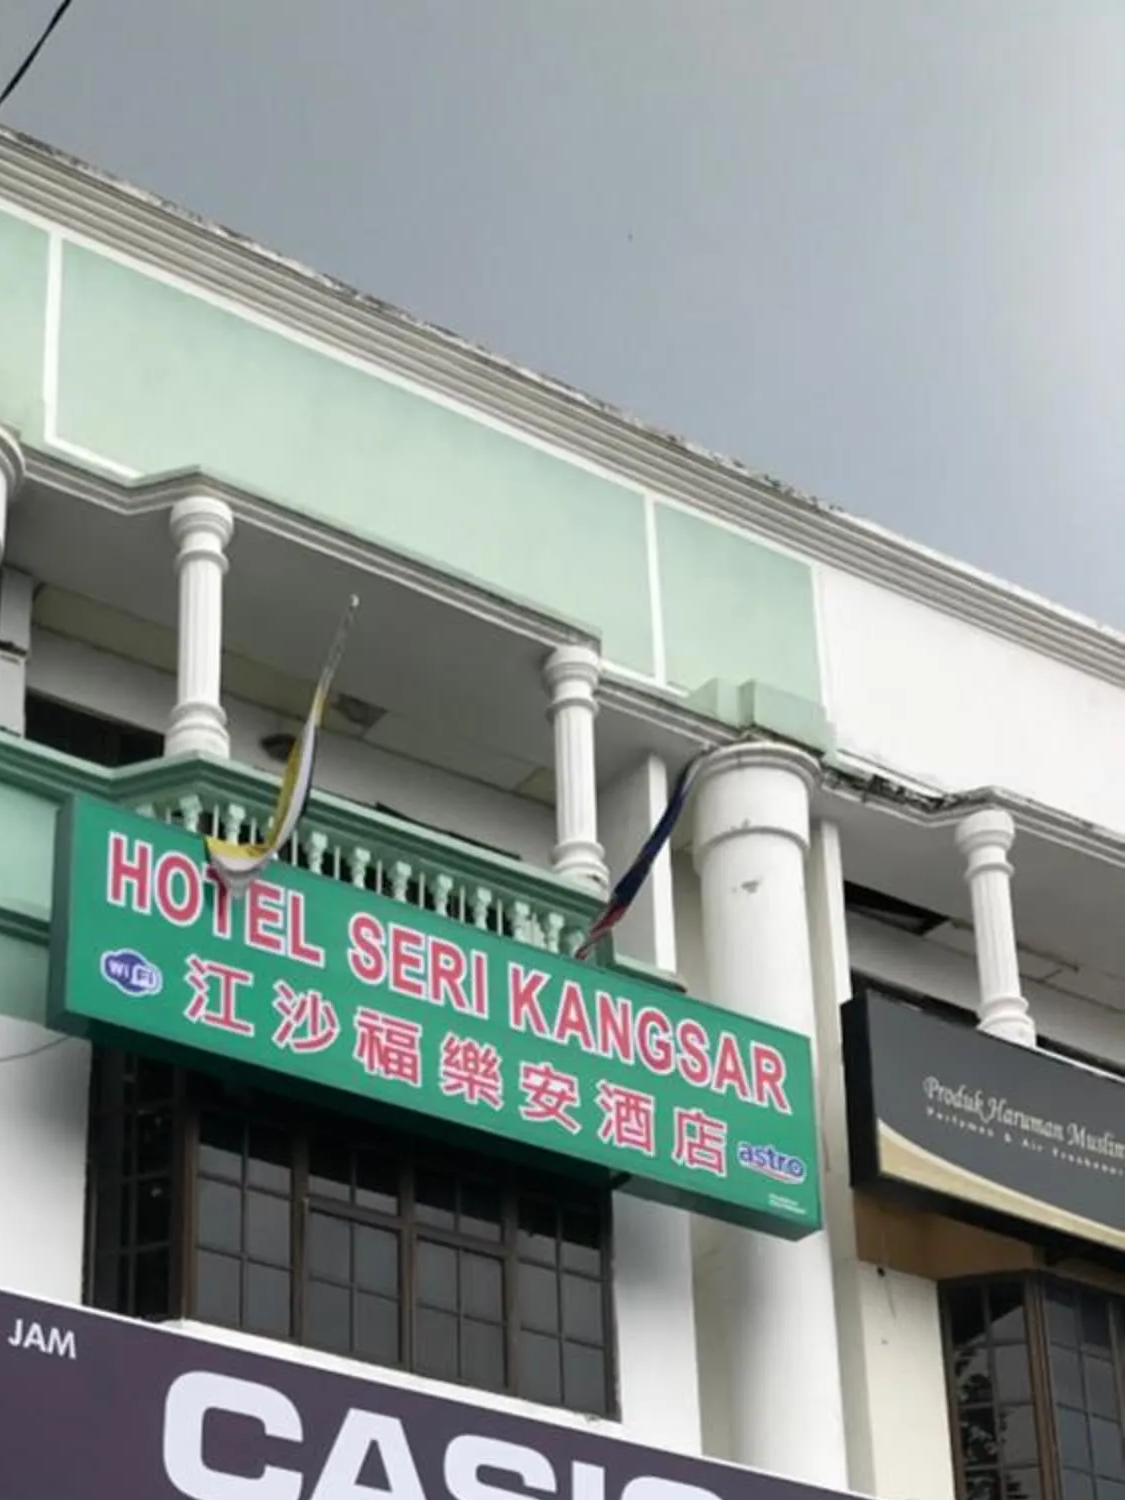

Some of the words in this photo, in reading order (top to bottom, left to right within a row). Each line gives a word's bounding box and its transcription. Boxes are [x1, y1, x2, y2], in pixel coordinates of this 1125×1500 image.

[106, 831, 325, 968] HOTEL
[347, 910, 490, 1021] SERI
[507, 963, 793, 1116] KANGSAR
[183, 955, 729, 1178] 江沙福樂安酒店
[923, 1077, 985, 1117] Produk
[738, 1142, 806, 1179] astro
[7, 1317, 77, 1361] JAM
